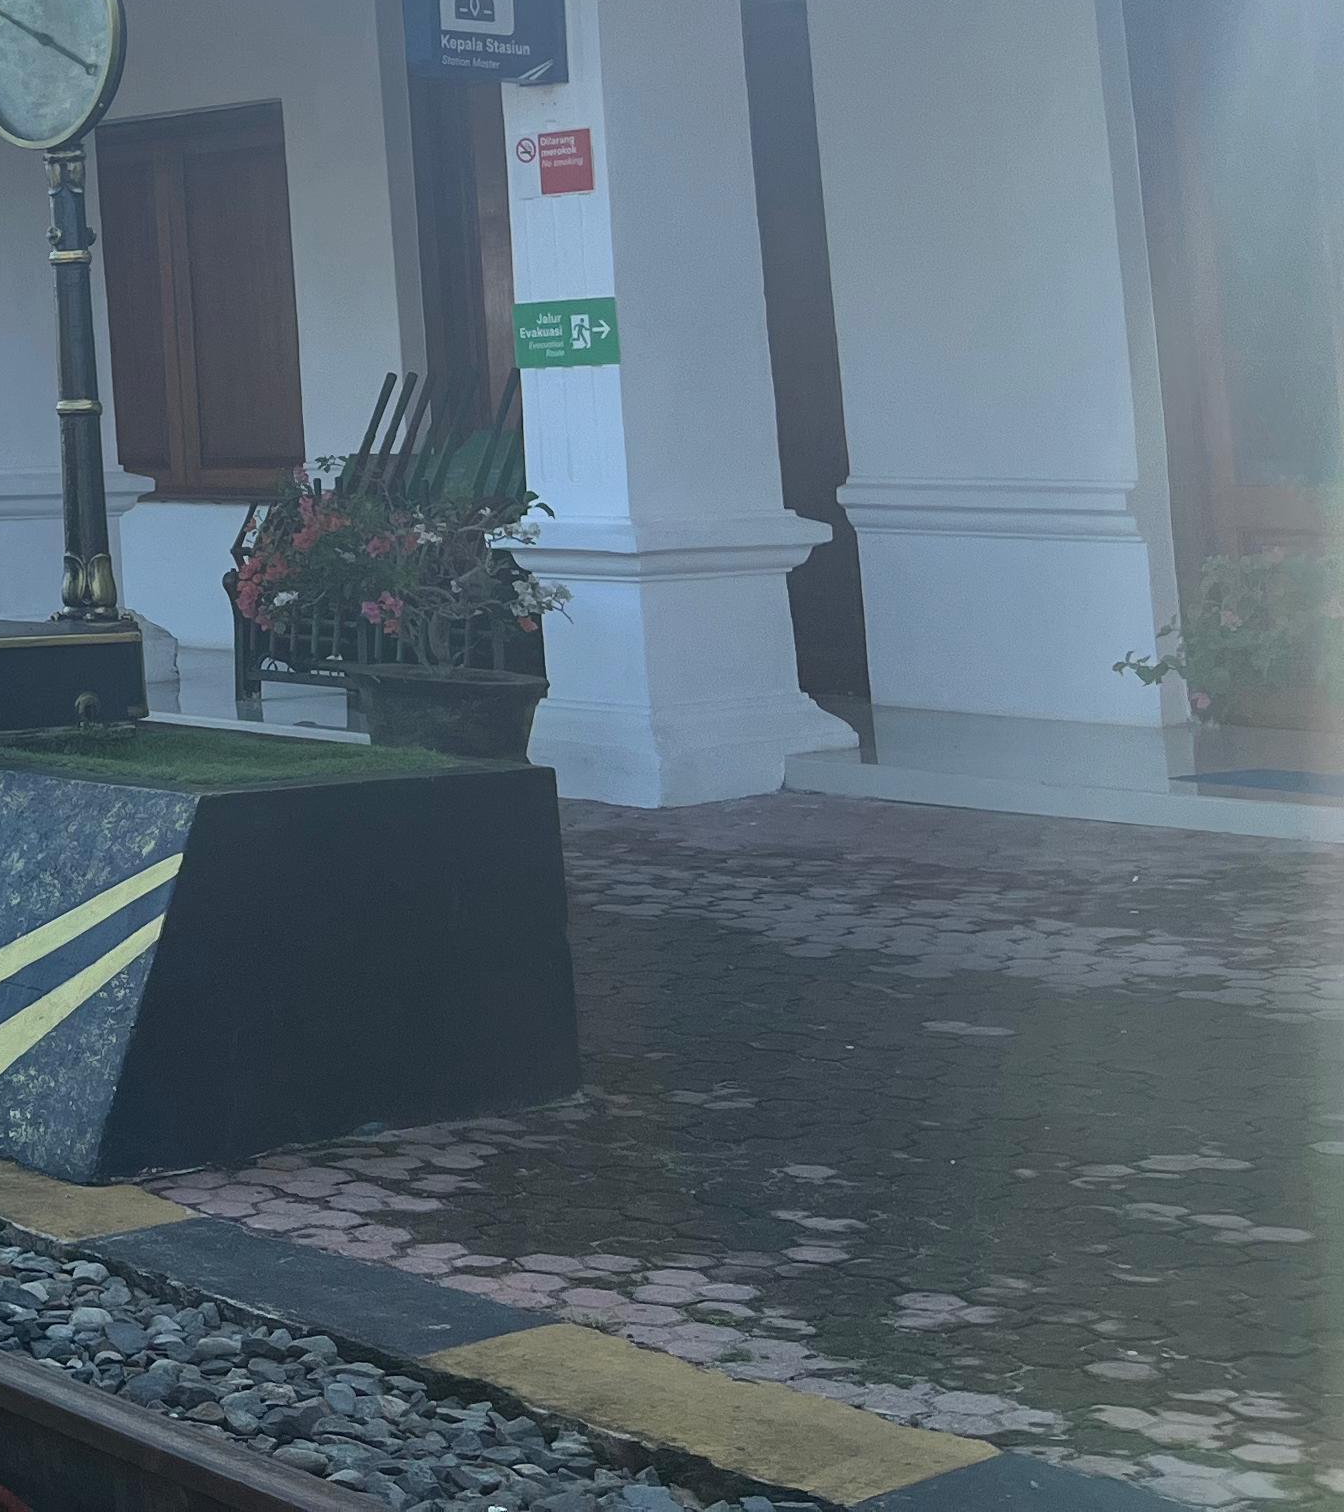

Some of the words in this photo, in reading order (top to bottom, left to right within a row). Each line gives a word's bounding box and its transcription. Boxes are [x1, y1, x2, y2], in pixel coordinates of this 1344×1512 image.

[441, 34, 483, 53] Kepala
[486, 38, 530, 55] Stasiun
[536, 313, 562, 324] Jalur
[520, 325, 562, 339] Evakuasi
